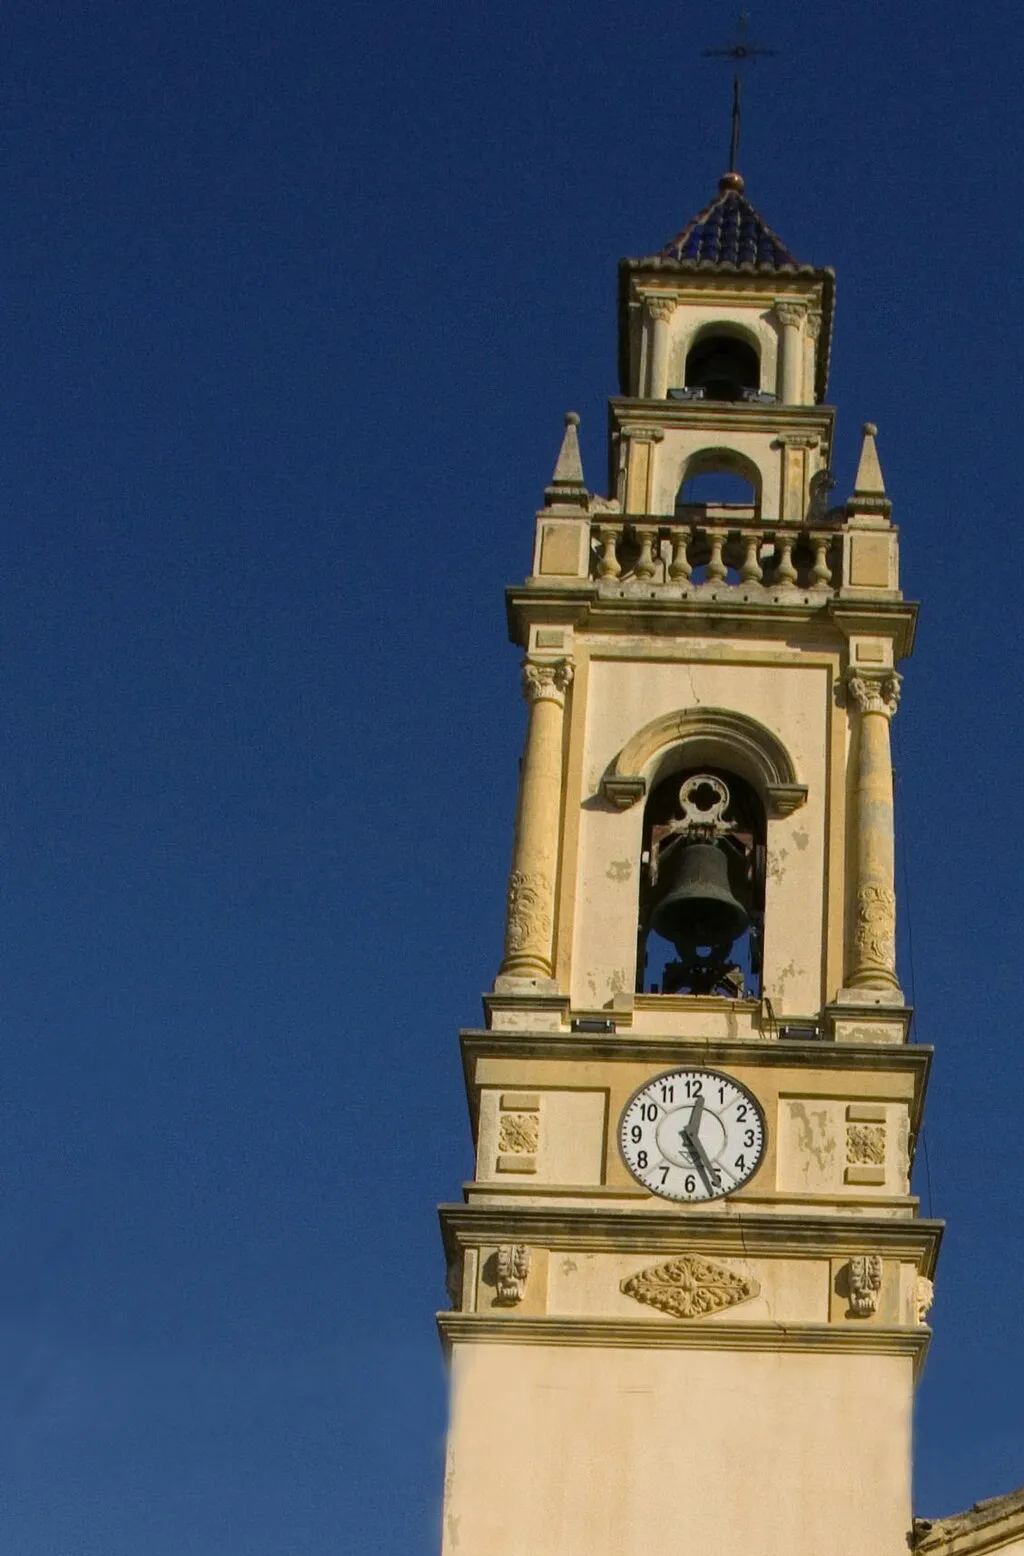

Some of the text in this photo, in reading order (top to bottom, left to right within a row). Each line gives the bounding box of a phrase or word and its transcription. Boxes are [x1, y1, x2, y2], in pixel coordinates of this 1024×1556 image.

[661, 1085, 674, 1103] 11
[684, 1080, 703, 1098] 12
[718, 1087, 724, 1104] 1
[640, 1103, 658, 1122] 10
[736, 1104, 747, 1122] 2
[631, 1125, 642, 1144] 9
[743, 1130, 755, 1148] 3
[637, 1150, 648, 1169] 8
[734, 1154, 745, 1172] 4
[659, 1166, 670, 1185] 7
[684, 1174, 696, 1193] 6
